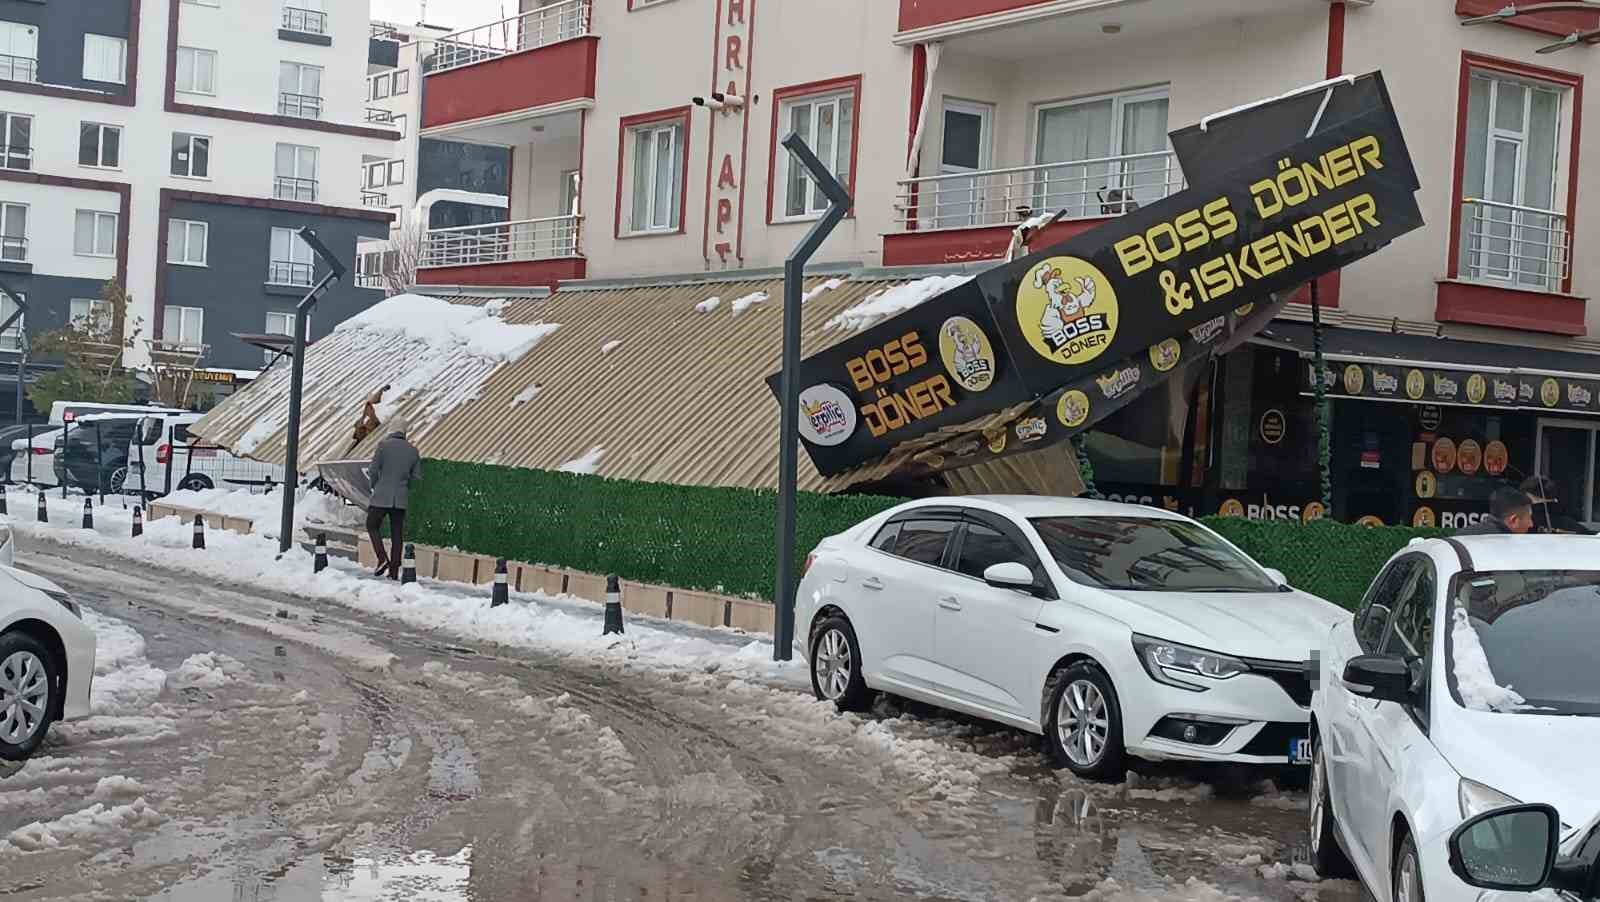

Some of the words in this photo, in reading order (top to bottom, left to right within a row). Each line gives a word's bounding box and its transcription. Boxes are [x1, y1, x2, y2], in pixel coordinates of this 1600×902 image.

[715, 153, 737, 262] APT
[1114, 197, 1238, 277] BOSS
[1250, 136, 1384, 219] DÖNER
[1052, 315, 1103, 346] BOSS
[1061, 334, 1107, 359] DÖNER
[846, 331, 928, 392] BOSS
[961, 360, 988, 378] BOSS
[860, 374, 957, 438] DÖNER
[1247, 504, 1300, 521] BOSS
